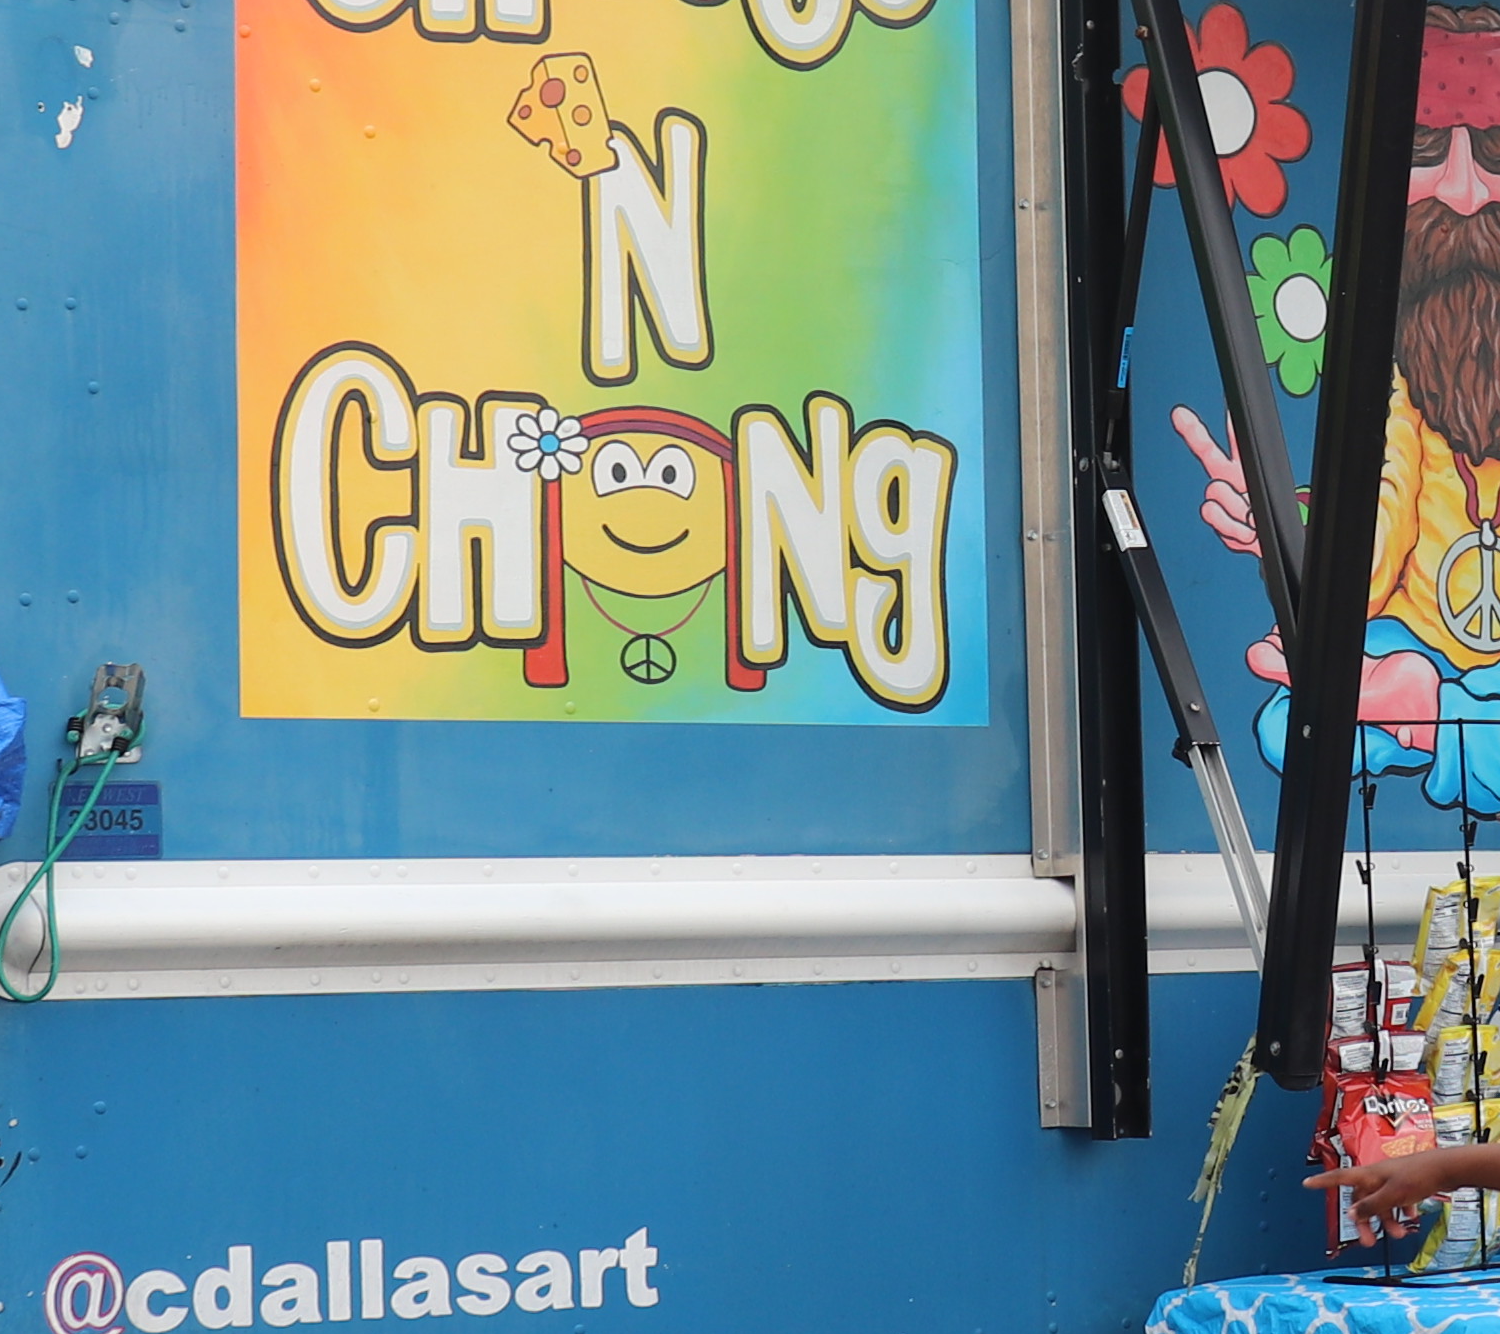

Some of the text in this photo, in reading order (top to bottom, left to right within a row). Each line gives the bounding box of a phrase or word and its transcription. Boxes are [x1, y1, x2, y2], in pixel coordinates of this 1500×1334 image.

[582, 109, 714, 386] N
[102, 787, 147, 803] WEST
[1364, 1095, 1430, 1116] Doritos
